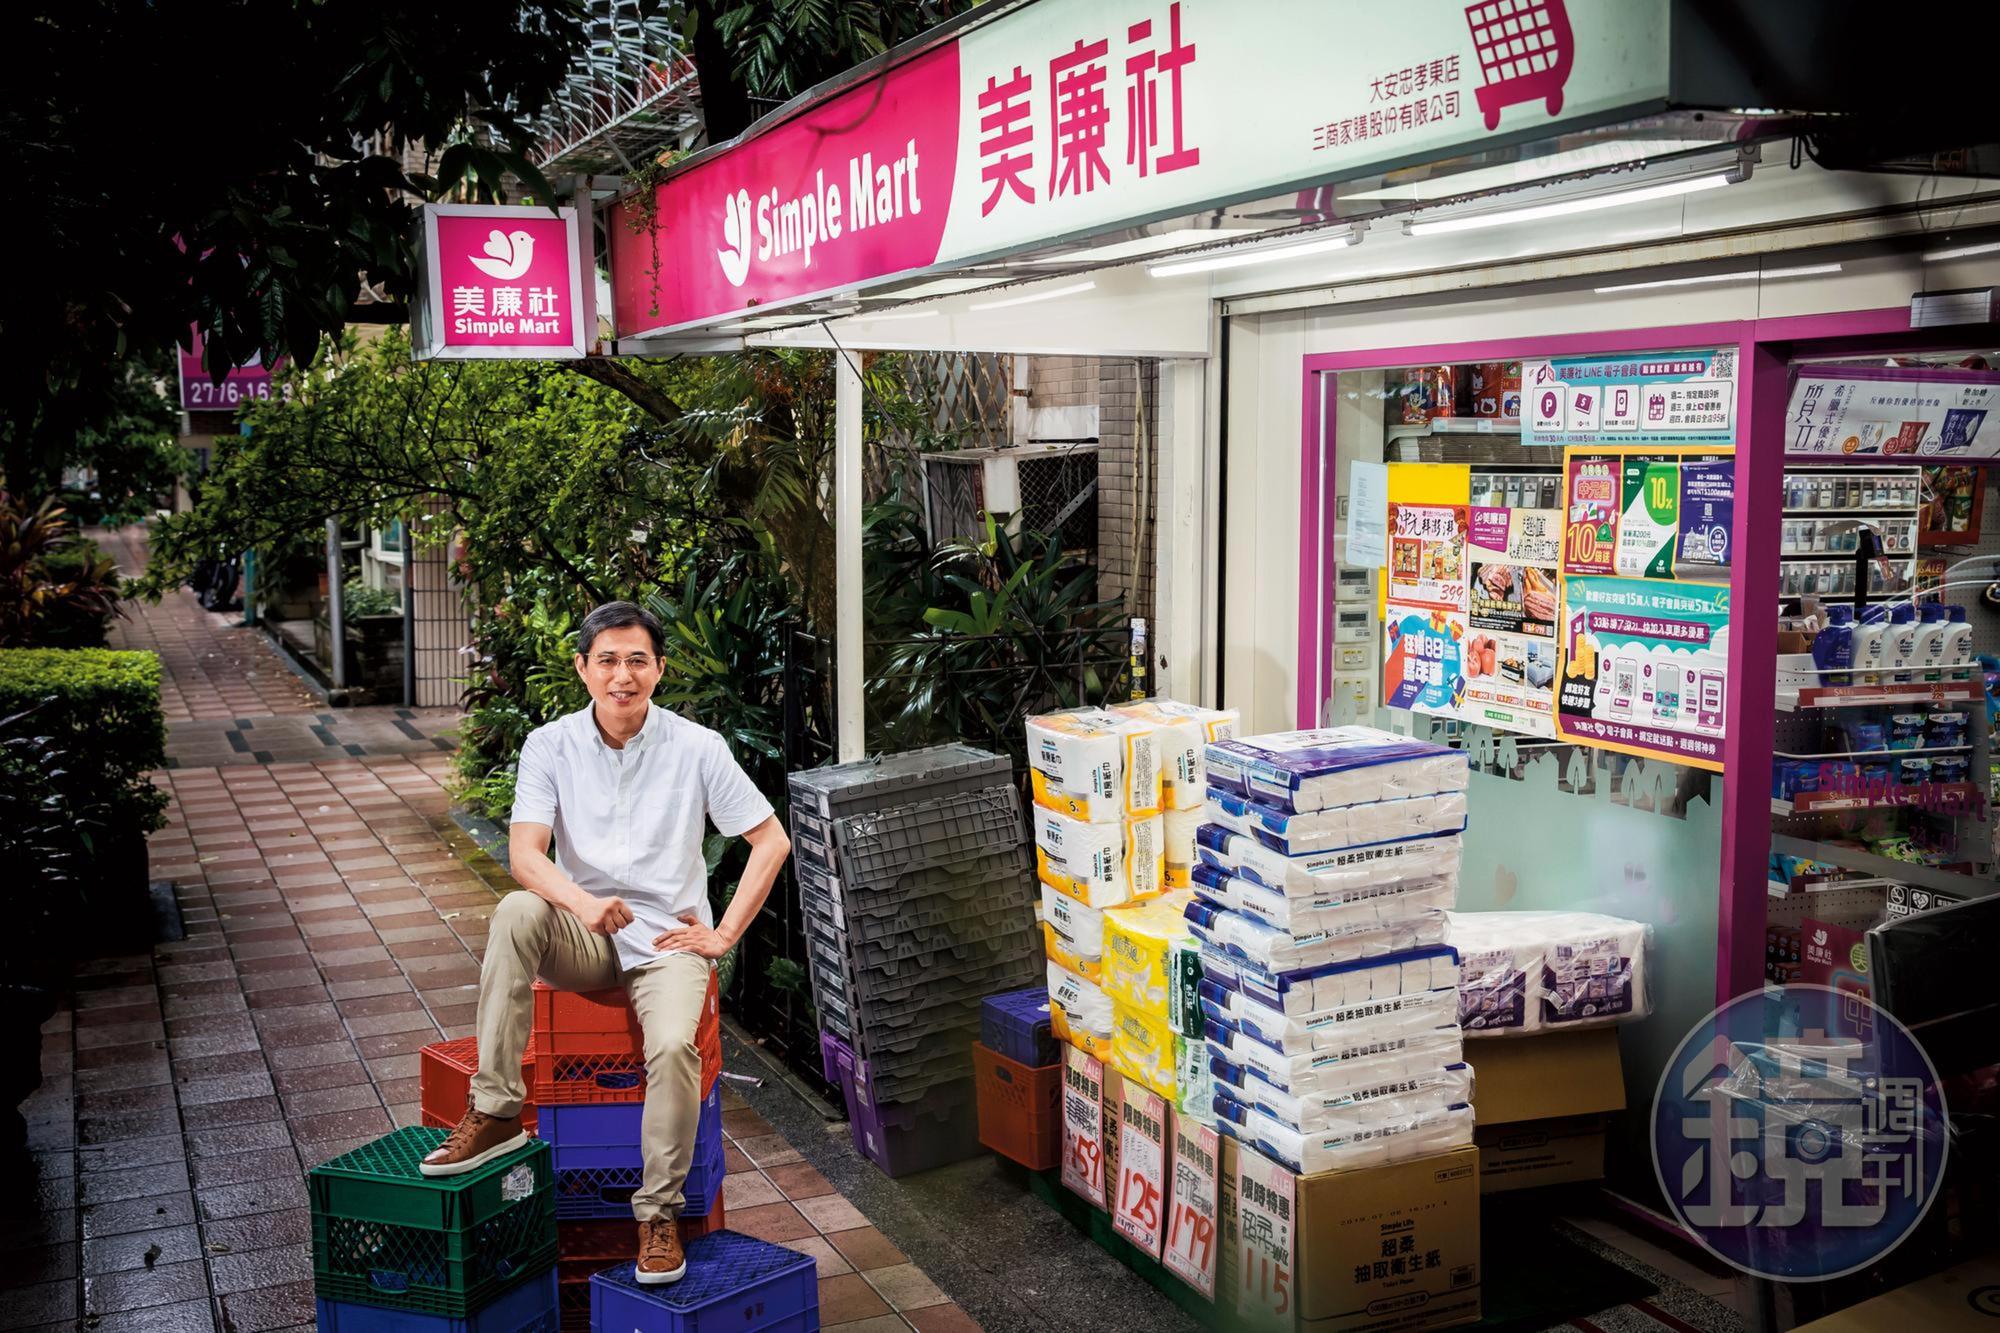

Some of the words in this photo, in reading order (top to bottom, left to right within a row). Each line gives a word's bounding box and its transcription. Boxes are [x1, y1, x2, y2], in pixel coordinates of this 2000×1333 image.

[1370, 54, 1460, 103] 大安忠孝東店
[978, 2, 1201, 218] 美廉社
[1312, 90, 1460, 151] 三商家購股份有限公司
[757, 168, 841, 267] Simple
[850, 138, 921, 233] Mart
[452, 286, 560, 317] 美廉社
[454, 318, 514, 337] Simple
[519, 318, 560, 334] Mart
[1819, 762, 1908, 807] Simple
[1807, 944, 1832, 961] 美廉社
[1065, 1063, 1099, 1102] 限時特惠
[1352, 1079, 1418, 1102] 超柔抽取衛生紙
[1123, 1102, 1161, 1144] 限時特惠
[1177, 1132, 1214, 1179] 限時特惠
[1121, 1167, 1160, 1231] 125
[1241, 1174, 1290, 1222] 限時特惠
[1171, 1201, 1215, 1272] 179
[1381, 1234, 1415, 1258] 超柔
[1246, 1247, 1290, 1316] 115
[1354, 1248, 1442, 1284] 抽取衛生紙
